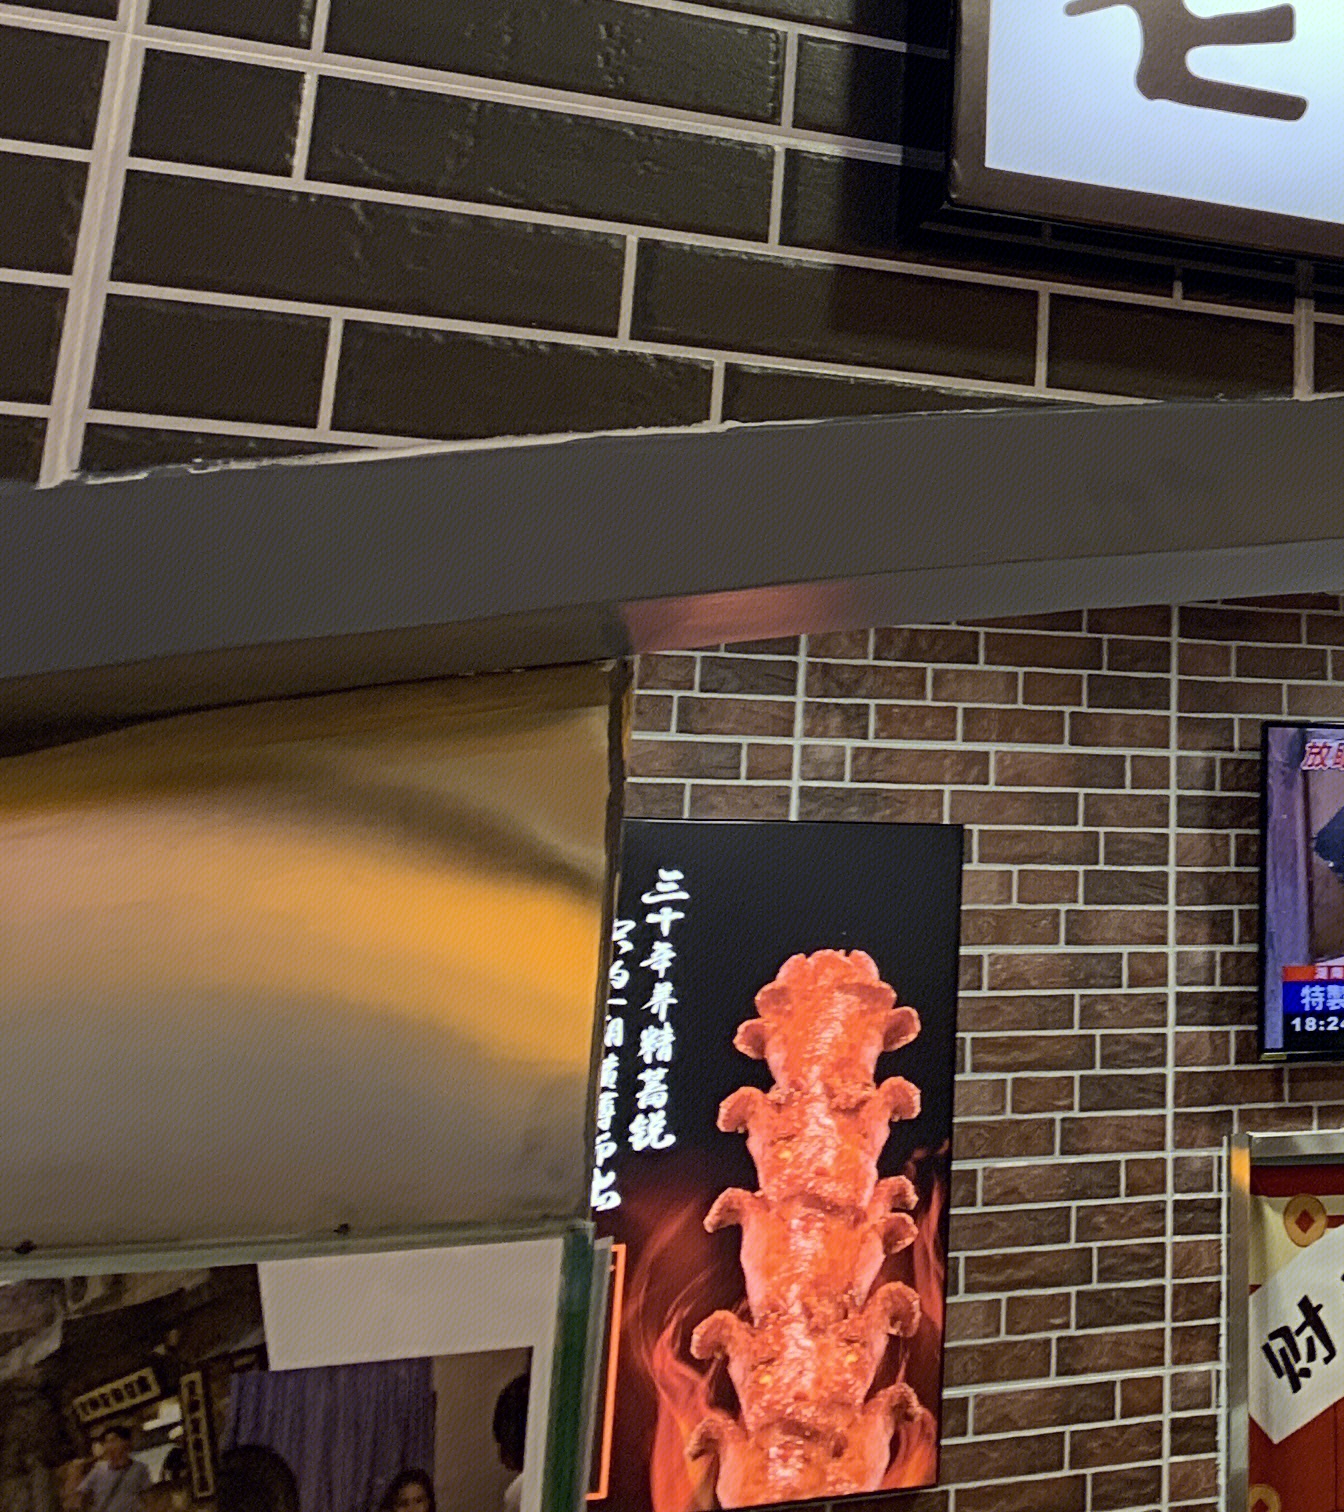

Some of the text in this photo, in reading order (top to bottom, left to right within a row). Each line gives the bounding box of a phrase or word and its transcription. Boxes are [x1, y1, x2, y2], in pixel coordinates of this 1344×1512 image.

[627, 867, 691, 1152] 三十年养精蓄锐
